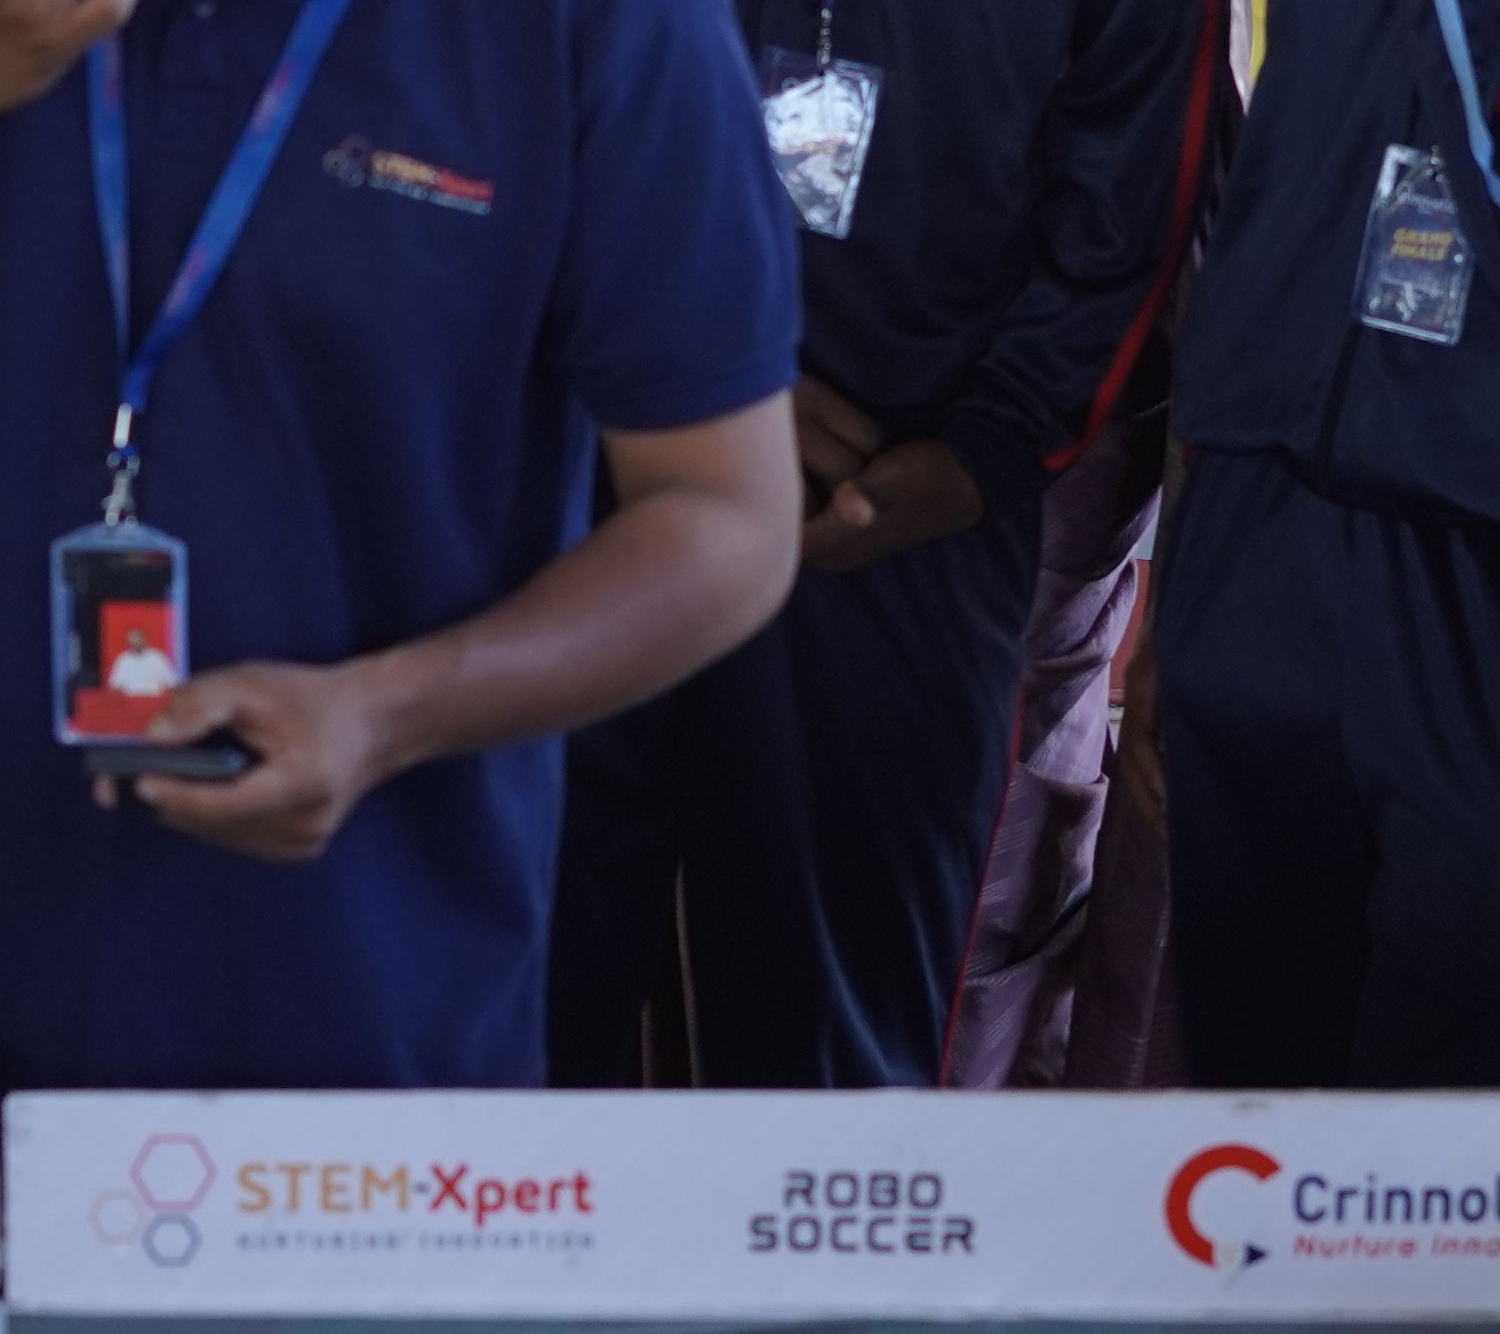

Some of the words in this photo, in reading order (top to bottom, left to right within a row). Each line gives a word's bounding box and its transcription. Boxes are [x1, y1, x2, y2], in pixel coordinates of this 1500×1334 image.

[237, 1163, 594, 1226] STEM-Xpert
[784, 1171, 942, 1210] ROBO
[750, 1215, 976, 1255] SOCCER
